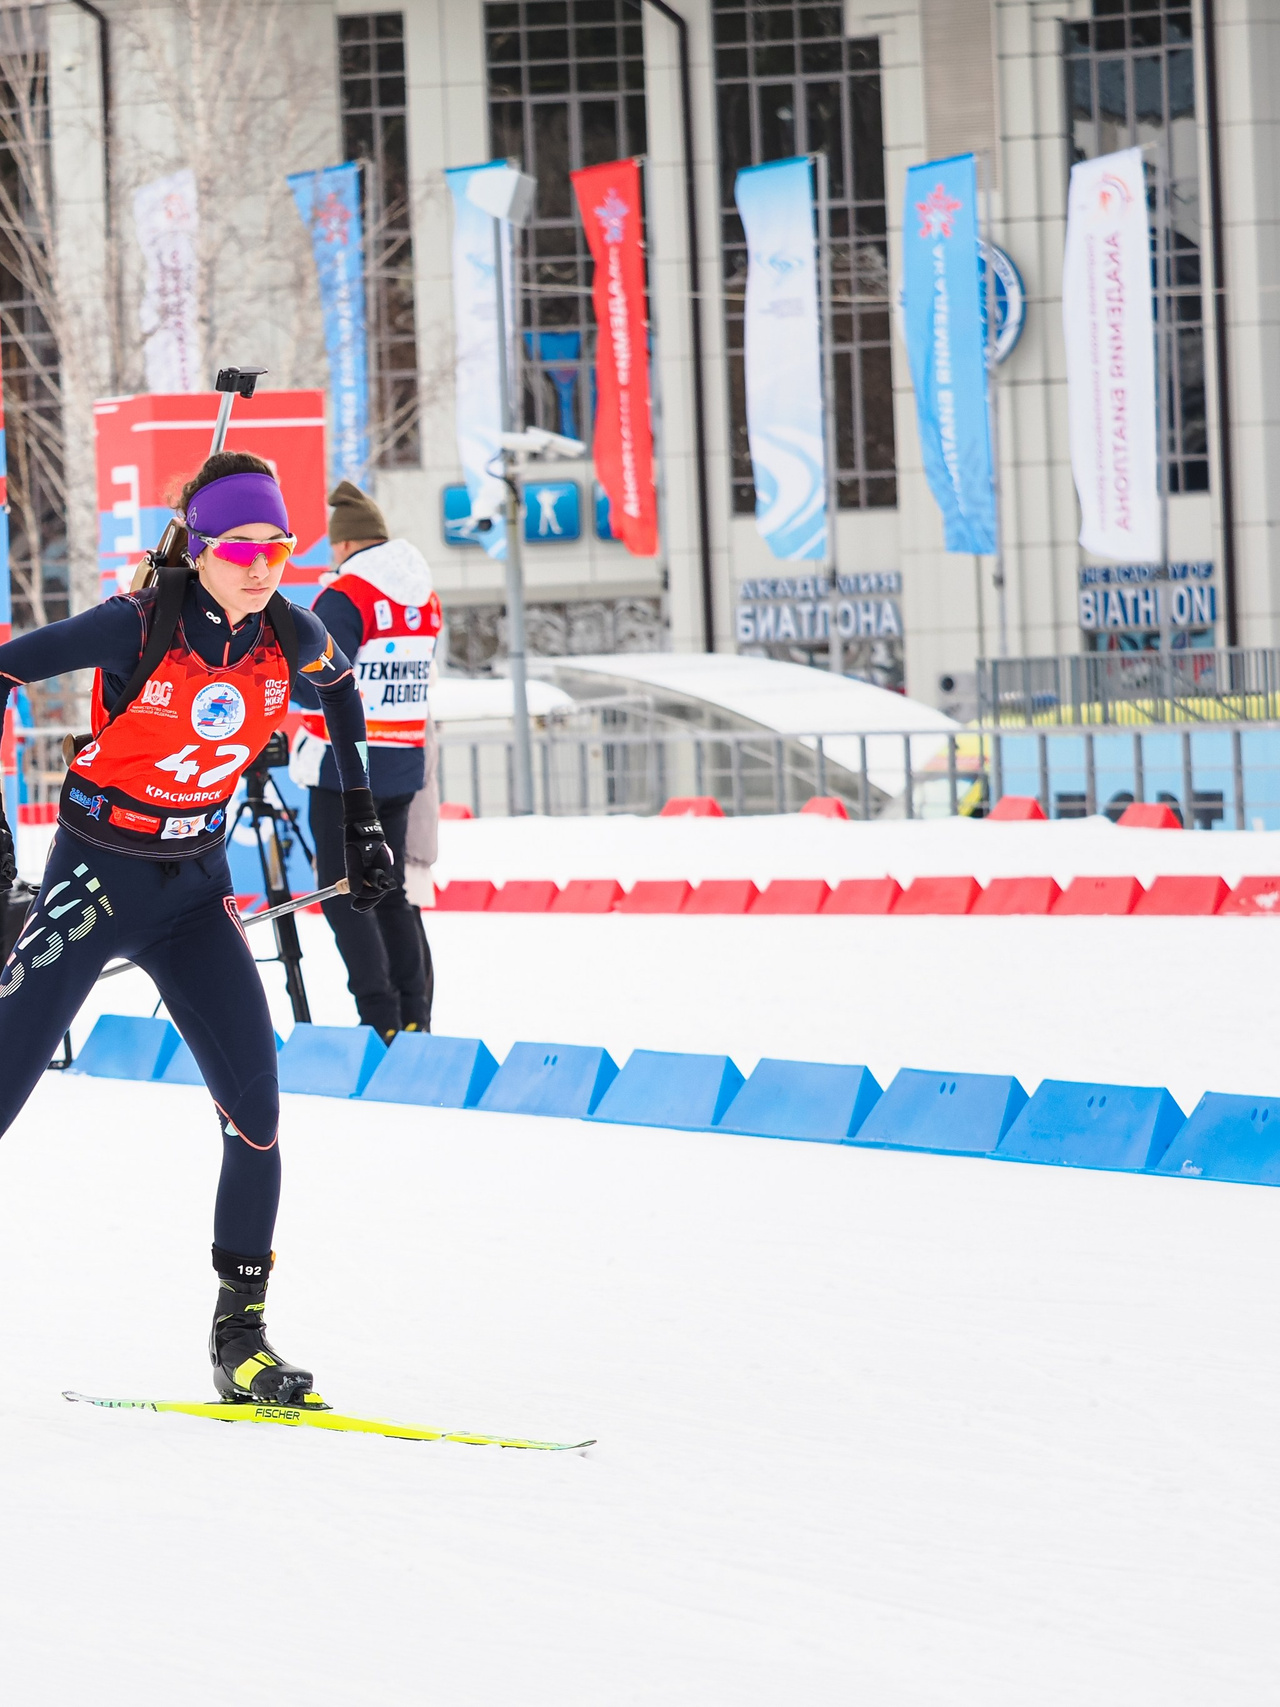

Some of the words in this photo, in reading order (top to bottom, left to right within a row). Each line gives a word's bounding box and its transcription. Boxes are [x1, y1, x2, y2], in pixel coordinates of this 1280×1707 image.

[735, 600, 902, 644] БИАТЛОНА
[360, 661, 431, 680] ТЕХНИЧЕС
[381, 683, 428, 706] ДЕЛЕГ
[154, 744, 251, 788] 42
[145, 784, 223, 802] КРАСНОЯРСК
[237, 1264, 262, 1276] 192
[244, 1302, 266, 1312] FIS
[255, 1408, 300, 1421] FISCHER
